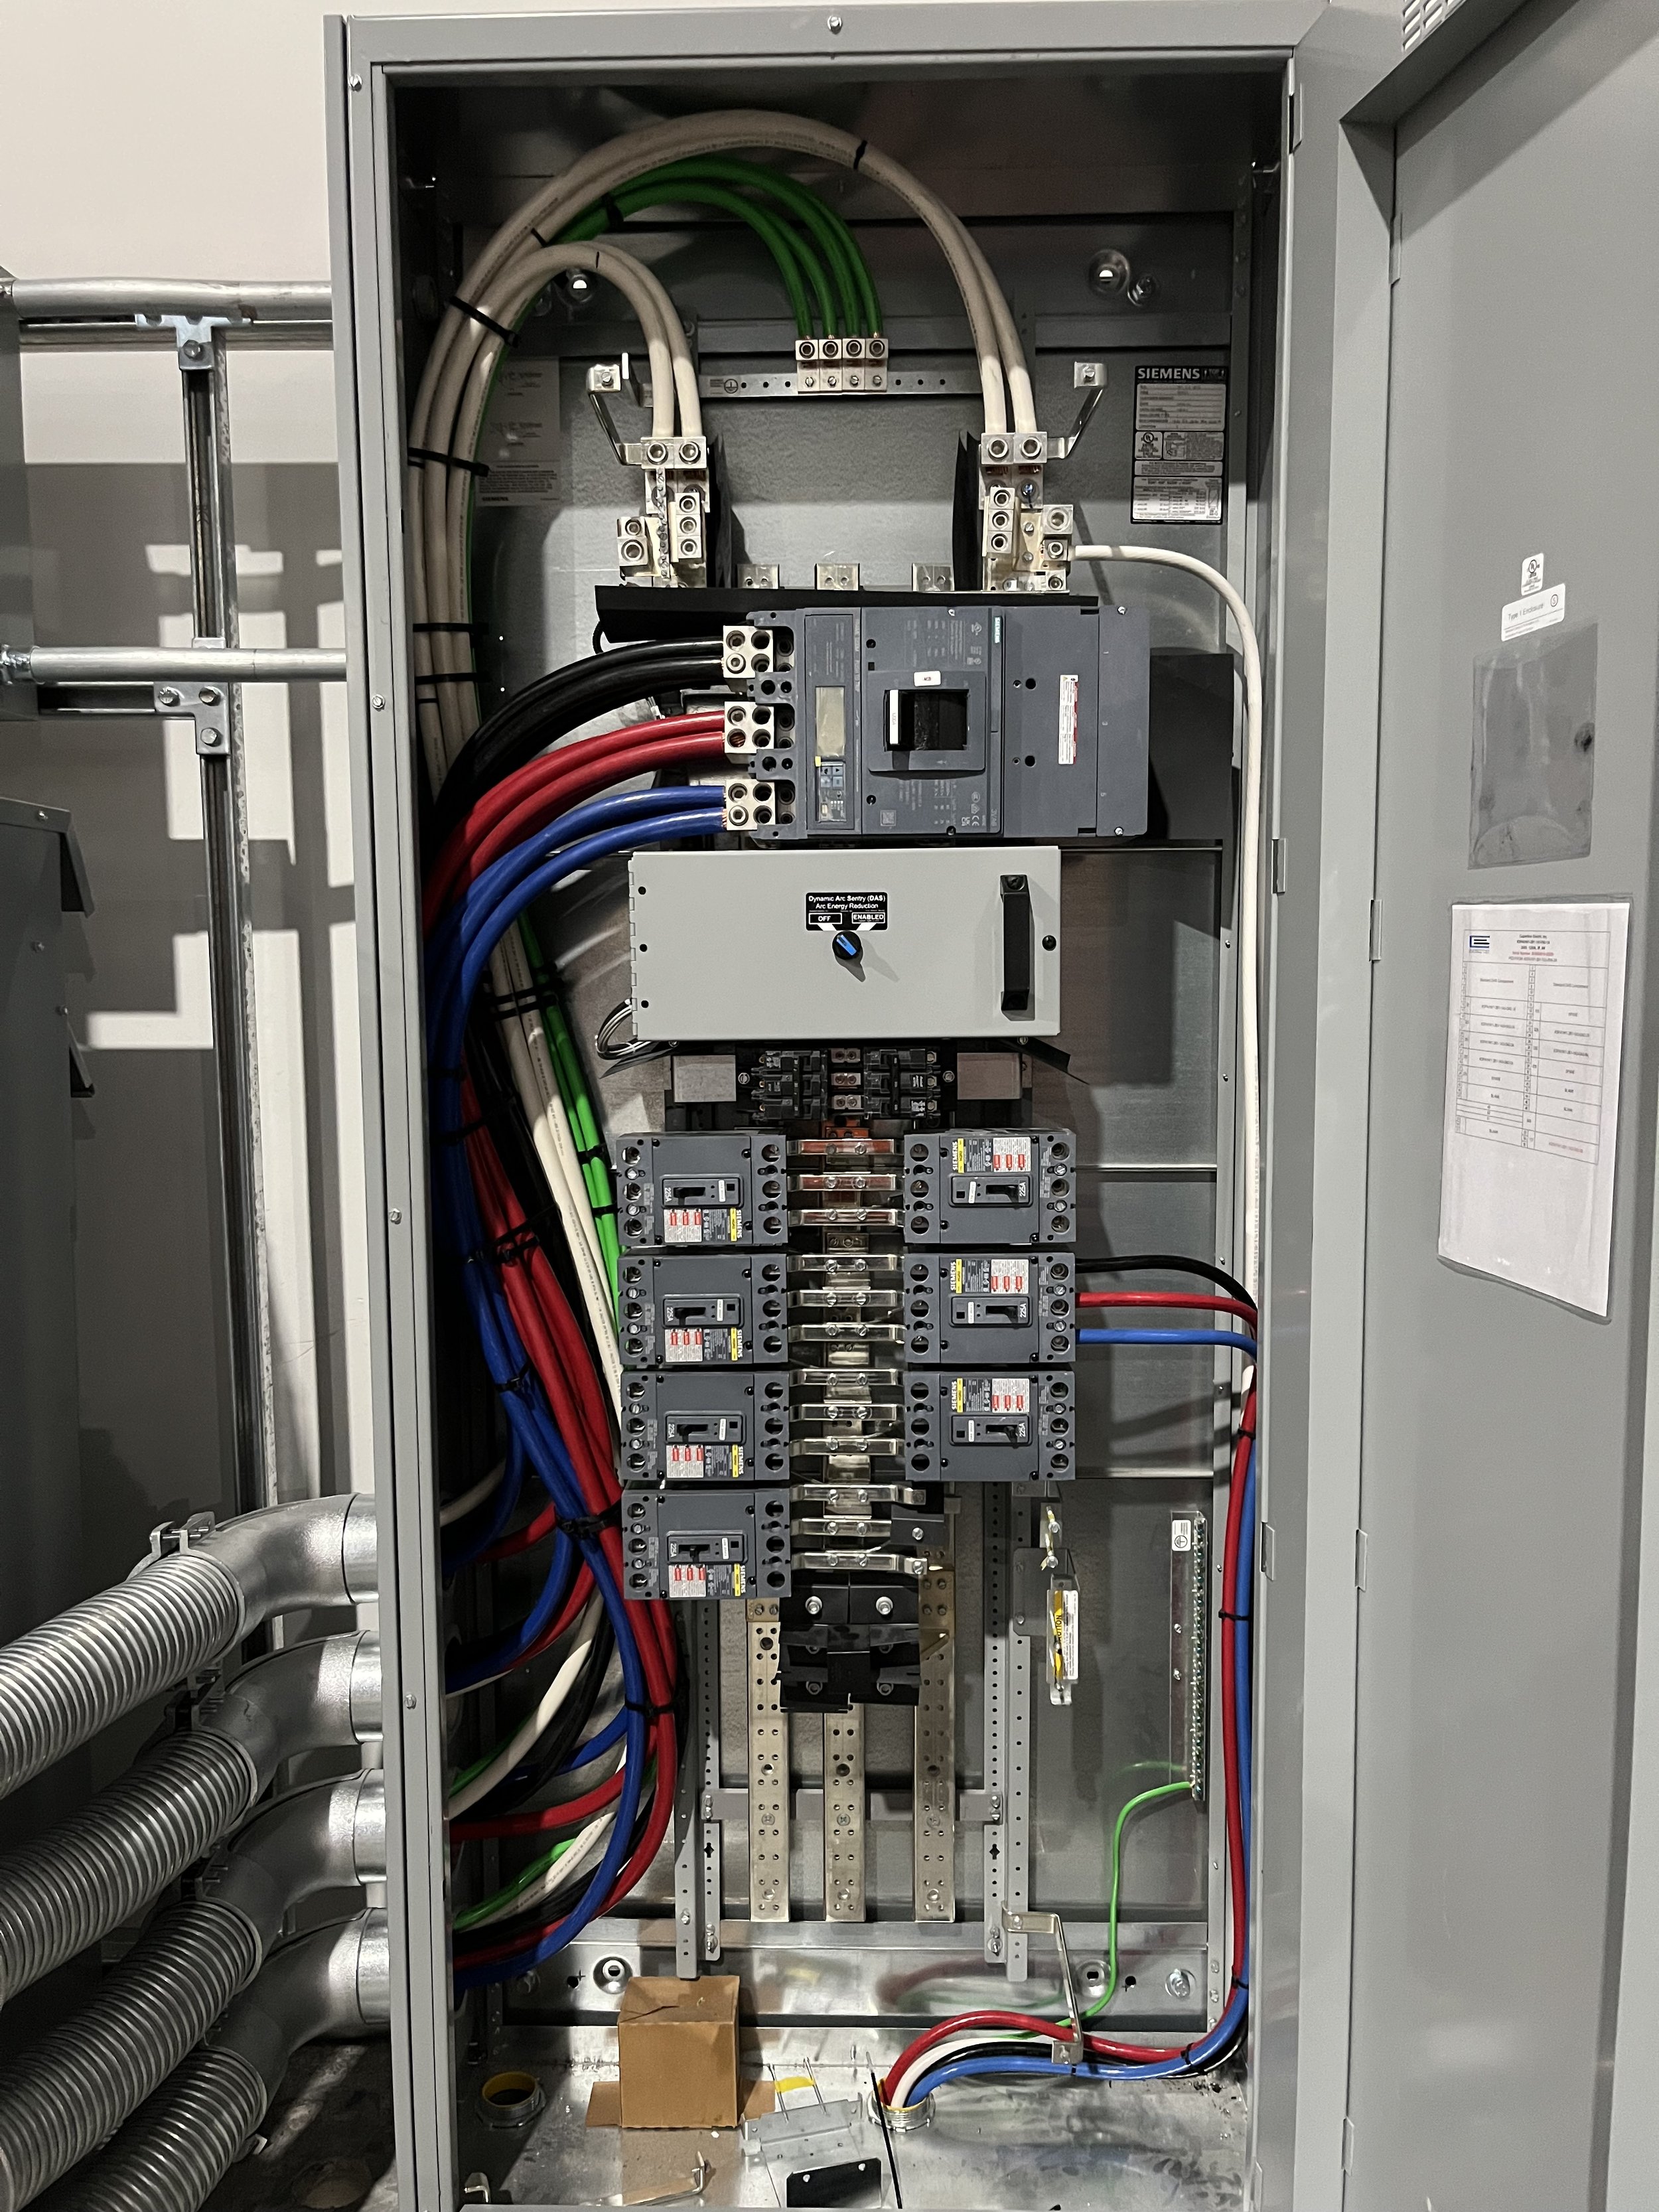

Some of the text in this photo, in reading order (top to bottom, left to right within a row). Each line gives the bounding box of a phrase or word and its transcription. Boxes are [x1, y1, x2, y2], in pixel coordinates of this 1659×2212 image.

[1137, 368, 1200, 379] SIEMENS
[1508, 613, 1518, 621] Type
[1522, 603, 1544, 615] Enclosure
